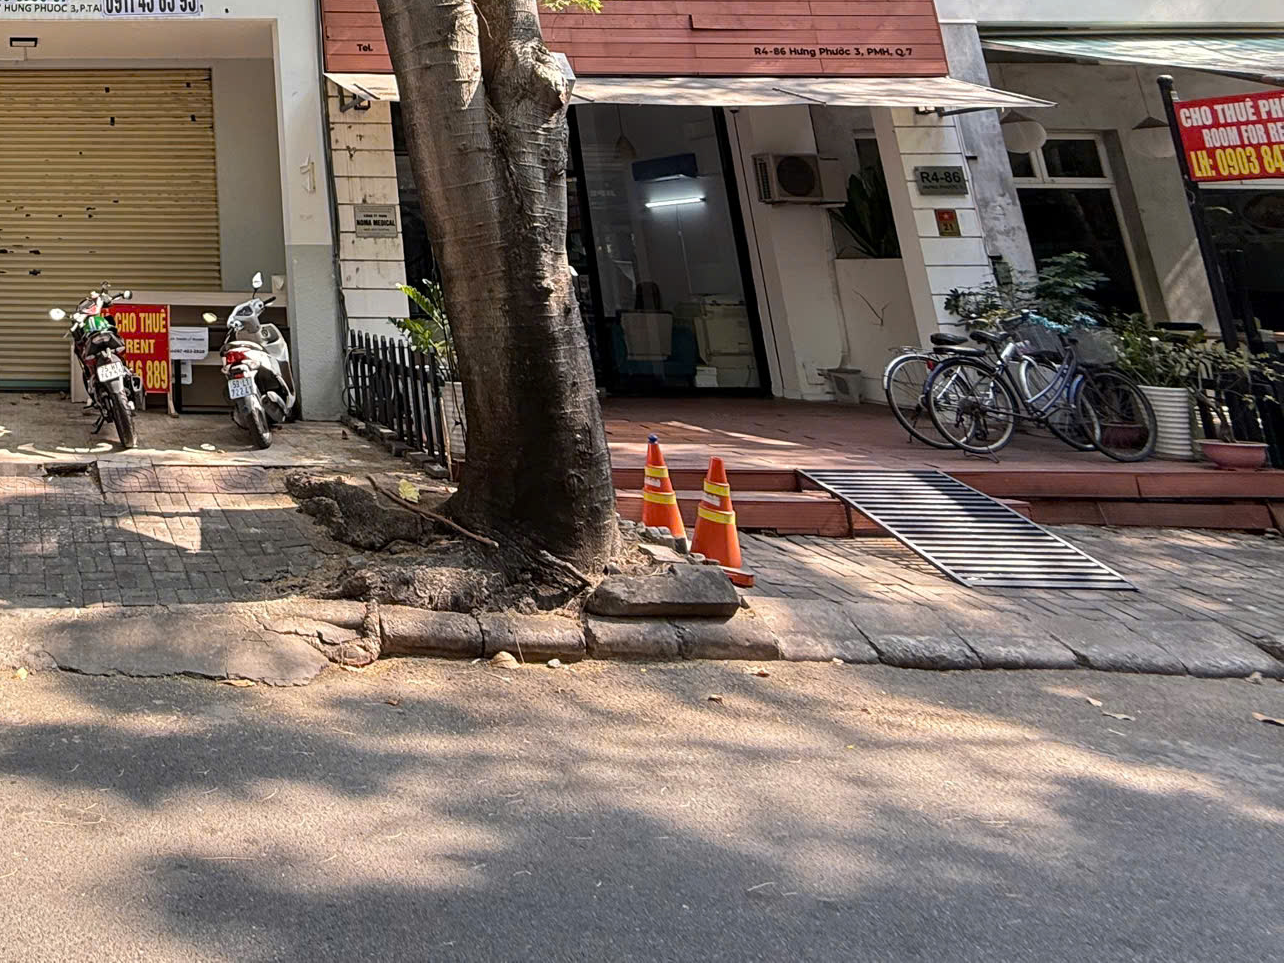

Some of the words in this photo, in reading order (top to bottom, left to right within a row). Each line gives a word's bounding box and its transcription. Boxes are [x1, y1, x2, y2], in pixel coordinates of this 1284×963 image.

[356, 43, 374, 52] Tel.
[754, 47, 787, 56] R4-86
[789, 47, 817, 57] Hưng
[1179, 105, 1213, 127] CHO
[1213, 97, 1257, 124] THUÊ
[1257, 93, 1284, 120] PH
[1201, 125, 1241, 148] ROOM
[1240, 123, 1268, 145] FOR
[1267, 121, 1284, 143] RE
[1189, 149, 1217, 177] LH:
[1214, 146, 1261, 176] 0903
[919, 171, 962, 184] R4-86
[115, 311, 137, 334] CHO
[139, 308, 167, 334] THUÊ
[125, 338, 156, 354] RENT
[146, 359, 168, 389] 889
